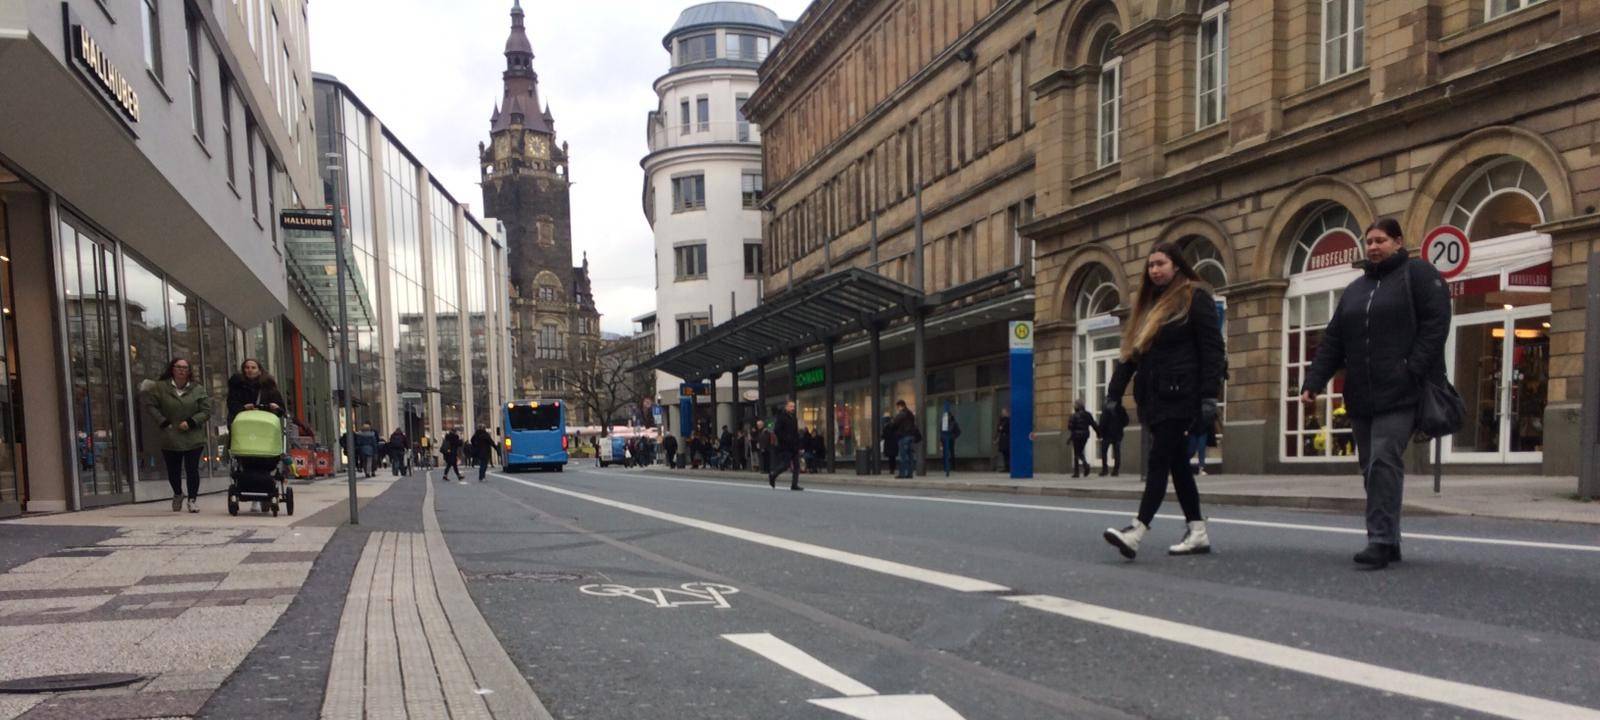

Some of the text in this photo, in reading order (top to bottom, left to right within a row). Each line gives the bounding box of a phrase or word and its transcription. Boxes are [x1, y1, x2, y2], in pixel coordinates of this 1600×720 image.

[81, 25, 139, 122] HALLHUBER
[284, 217, 333, 226] HALLHUBER
[1433, 241, 1460, 264] 20
